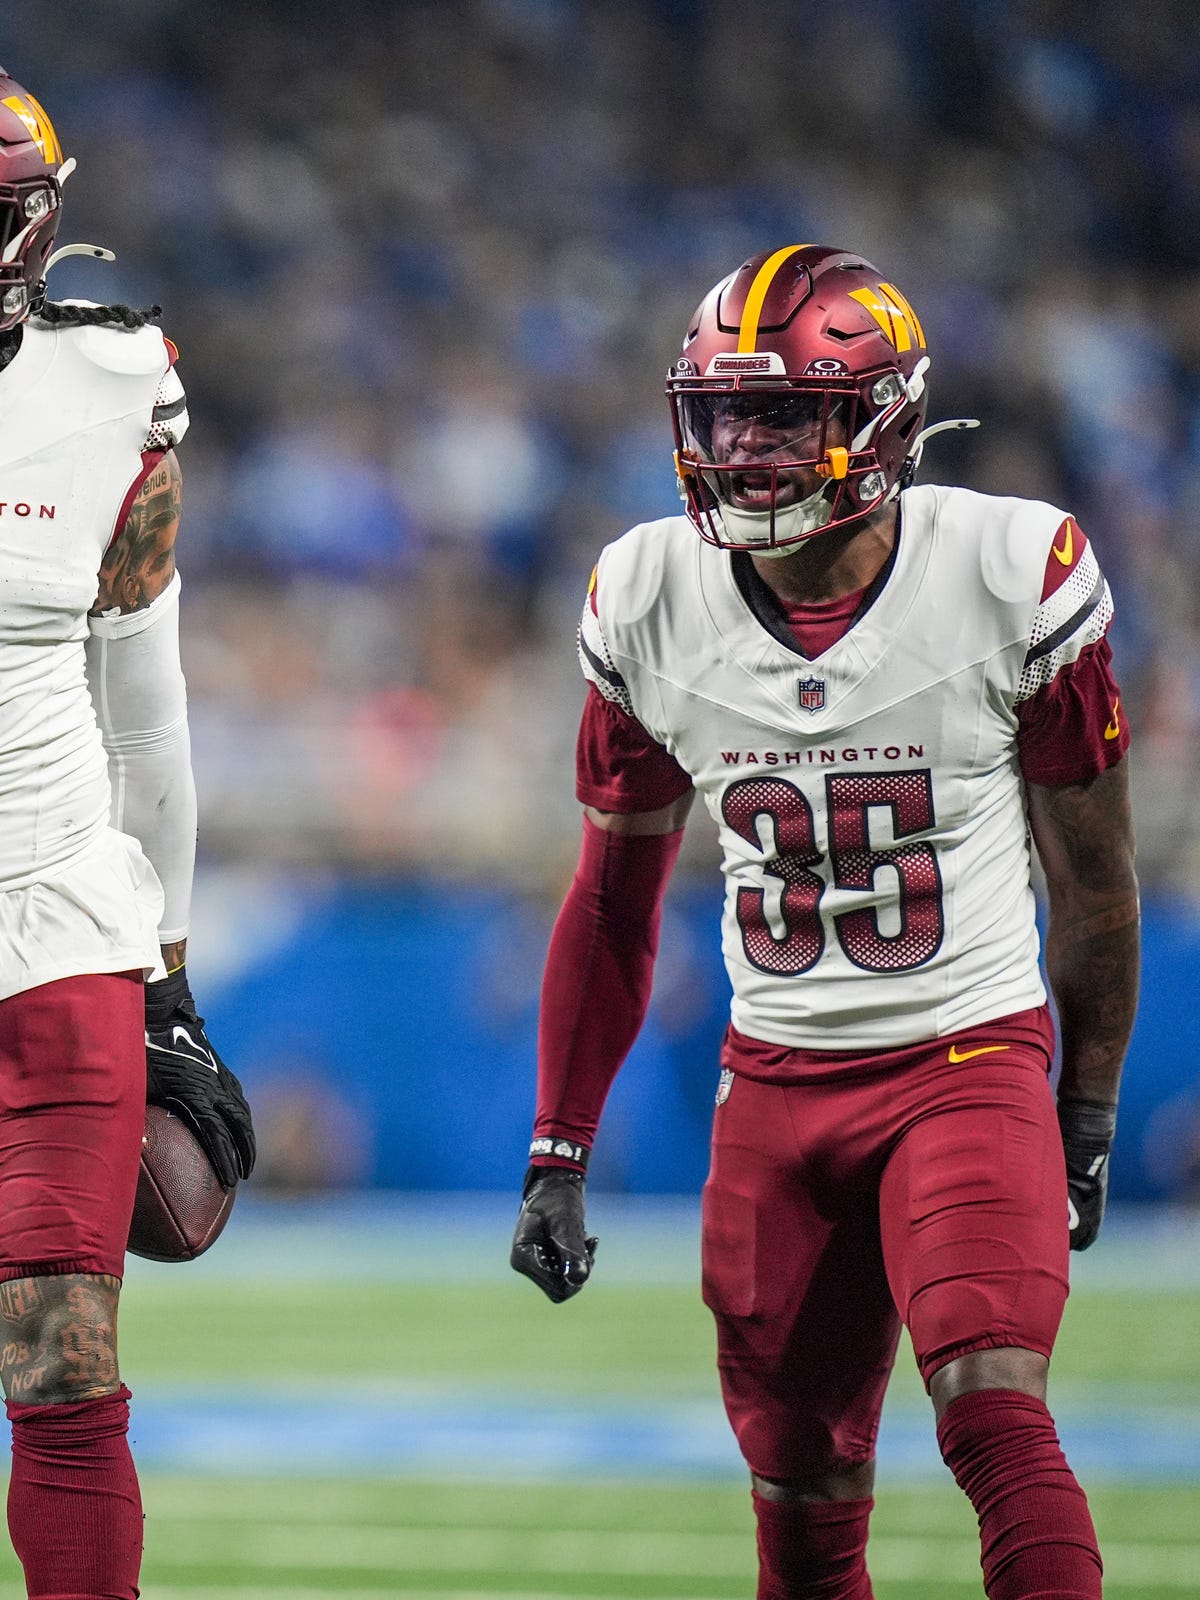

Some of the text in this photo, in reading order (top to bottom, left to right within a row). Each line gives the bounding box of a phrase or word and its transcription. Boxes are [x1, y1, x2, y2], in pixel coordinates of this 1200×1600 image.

[714, 358, 771, 370] COMMANDERS
[802, 691, 823, 707] NFL
[720, 744, 924, 765] WASHINGTON
[721, 768, 945, 977] 35
